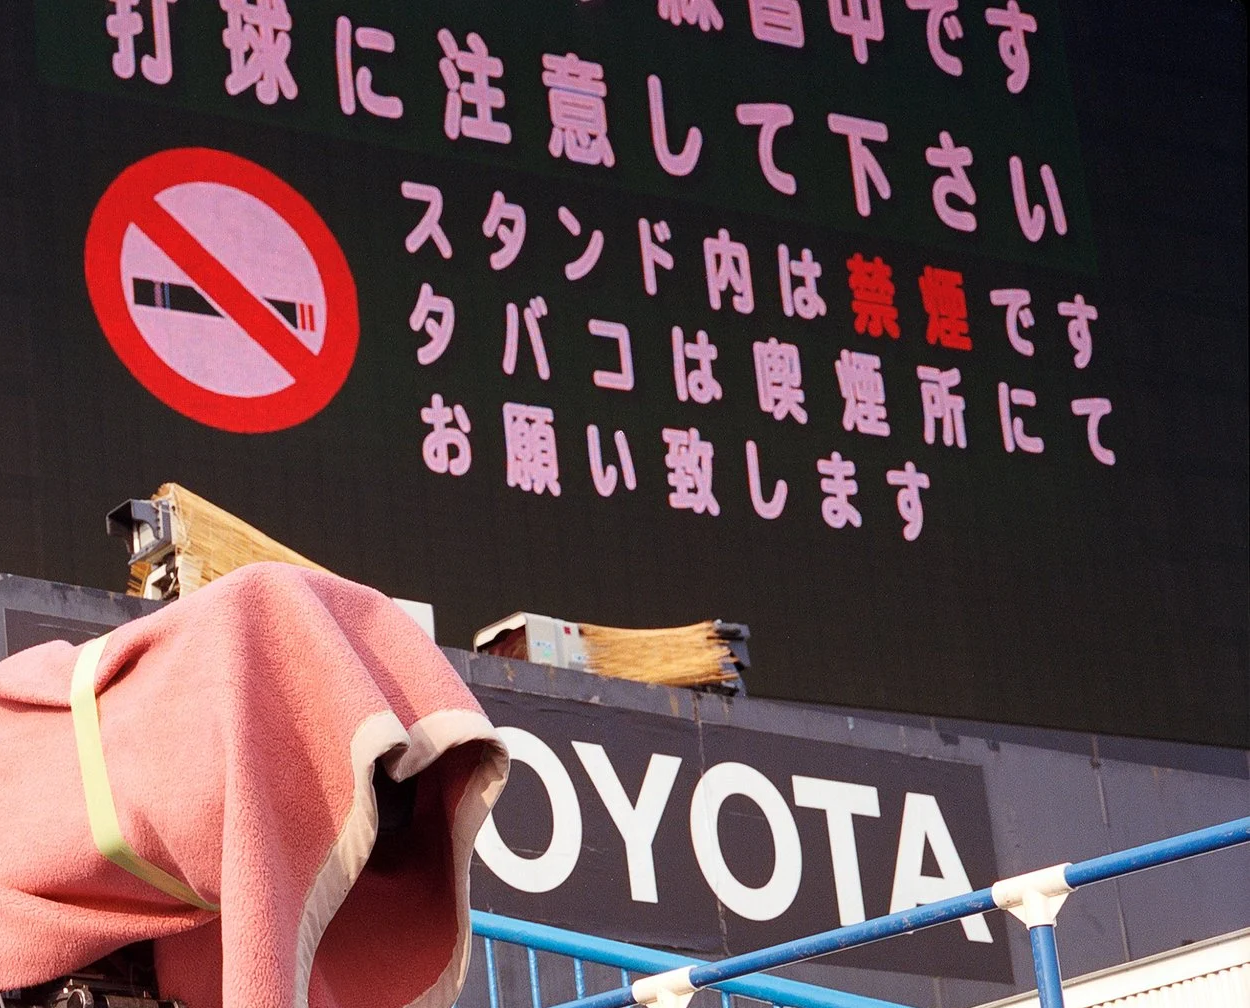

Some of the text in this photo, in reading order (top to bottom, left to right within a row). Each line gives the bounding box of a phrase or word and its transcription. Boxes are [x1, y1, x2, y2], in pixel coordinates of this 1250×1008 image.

[106, 0, 1068, 243] 打球に注意して下さい
[400, 180, 1099, 370] スタンド内は禁煙です
[408, 282, 1116, 466] タバコは喫煙所にて
[420, 393, 931, 541] お願い致します
